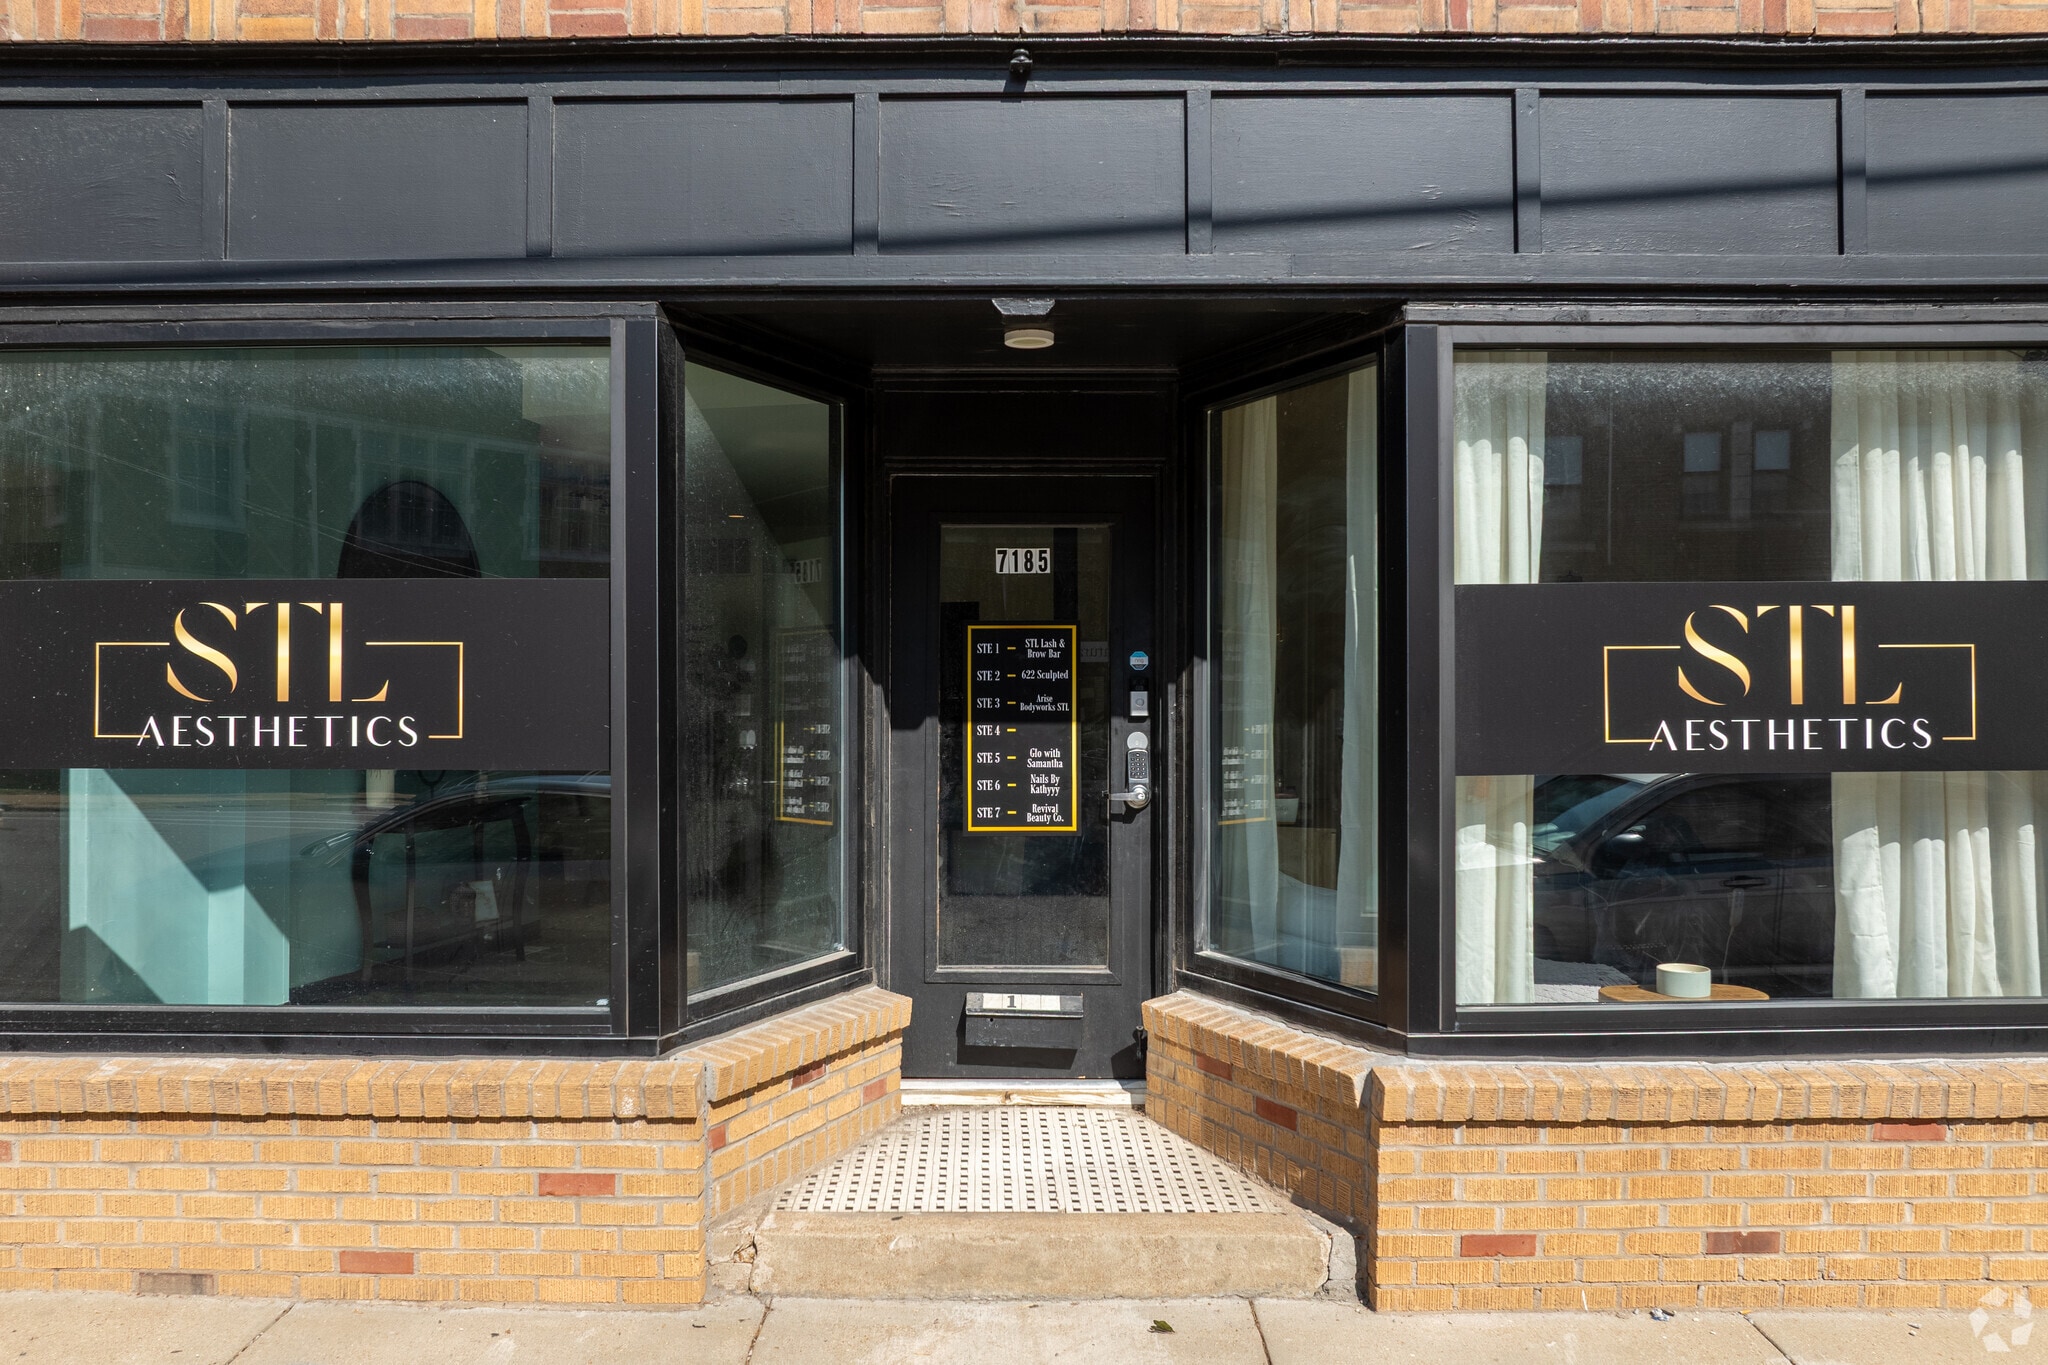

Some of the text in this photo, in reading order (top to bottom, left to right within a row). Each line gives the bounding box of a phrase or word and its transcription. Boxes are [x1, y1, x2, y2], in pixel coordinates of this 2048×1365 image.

[996, 549, 1049, 573] 7185
[976, 642, 999, 654] STE 1
[1024, 638, 1066, 649] STL Lash &
[166, 602, 390, 703] STL
[1027, 648, 1062, 659] Brow Bar
[1678, 605, 1902, 705] STL
[976, 669, 1069, 682] STE 2 622 Sculpted
[976, 697, 1001, 709] STE 3
[1036, 694, 1054, 703] Arise
[1019, 702, 1070, 714] Bodyworks STL
[137, 714, 419, 748] AESTHETICS
[976, 724, 1001, 736] STE 4
[1649, 718, 1933, 751] AESTHETICS
[976, 752, 1001, 764] STE 5
[1029, 747, 1061, 758] Glo with
[1026, 758, 1064, 768] Samantha
[976, 779, 1001, 791] STE 6
[1030, 773, 1061, 786] Nails By
[1030, 784, 1061, 797] Kathyyy
[976, 806, 1001, 819] STE 7
[1032, 803, 1059, 814] Revival
[1026, 812, 1065, 825] Beauty Co.
[1006, 994, 1018, 1009] 1
